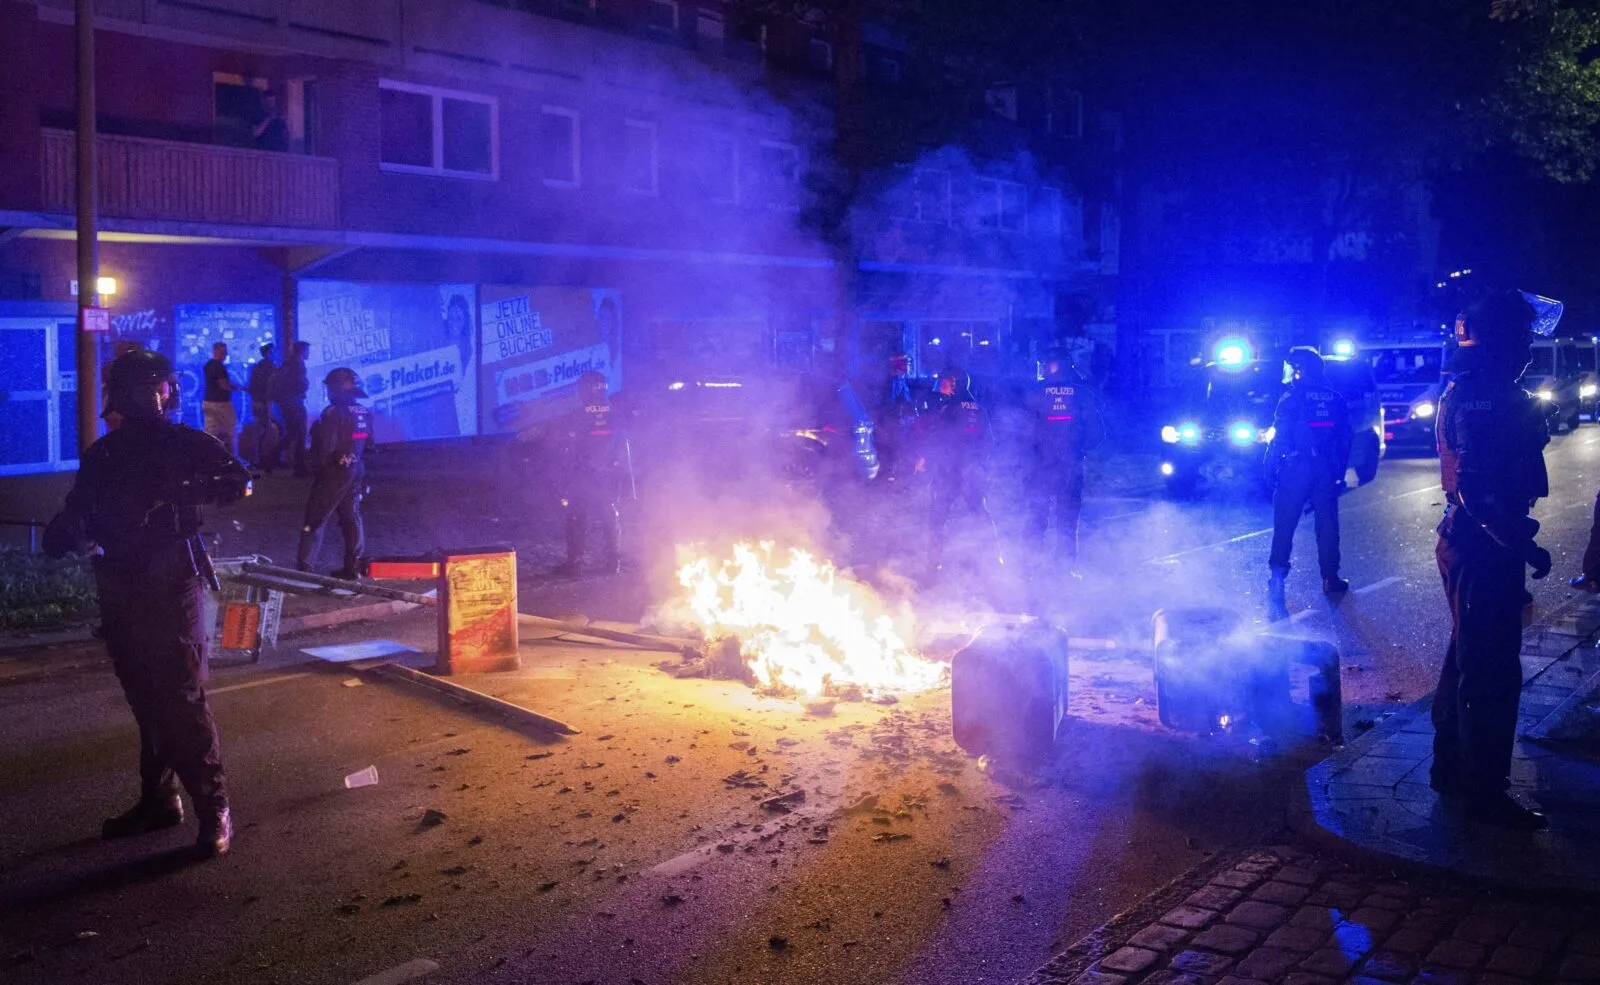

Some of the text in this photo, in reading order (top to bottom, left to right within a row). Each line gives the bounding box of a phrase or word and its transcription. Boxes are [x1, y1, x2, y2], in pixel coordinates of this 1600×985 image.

[495, 297, 529, 319] JETZT
[496, 314, 540, 339] ONLINE
[499, 329, 552, 358] BUCHEN!
[1045, 386, 1074, 396] POLIZEI
